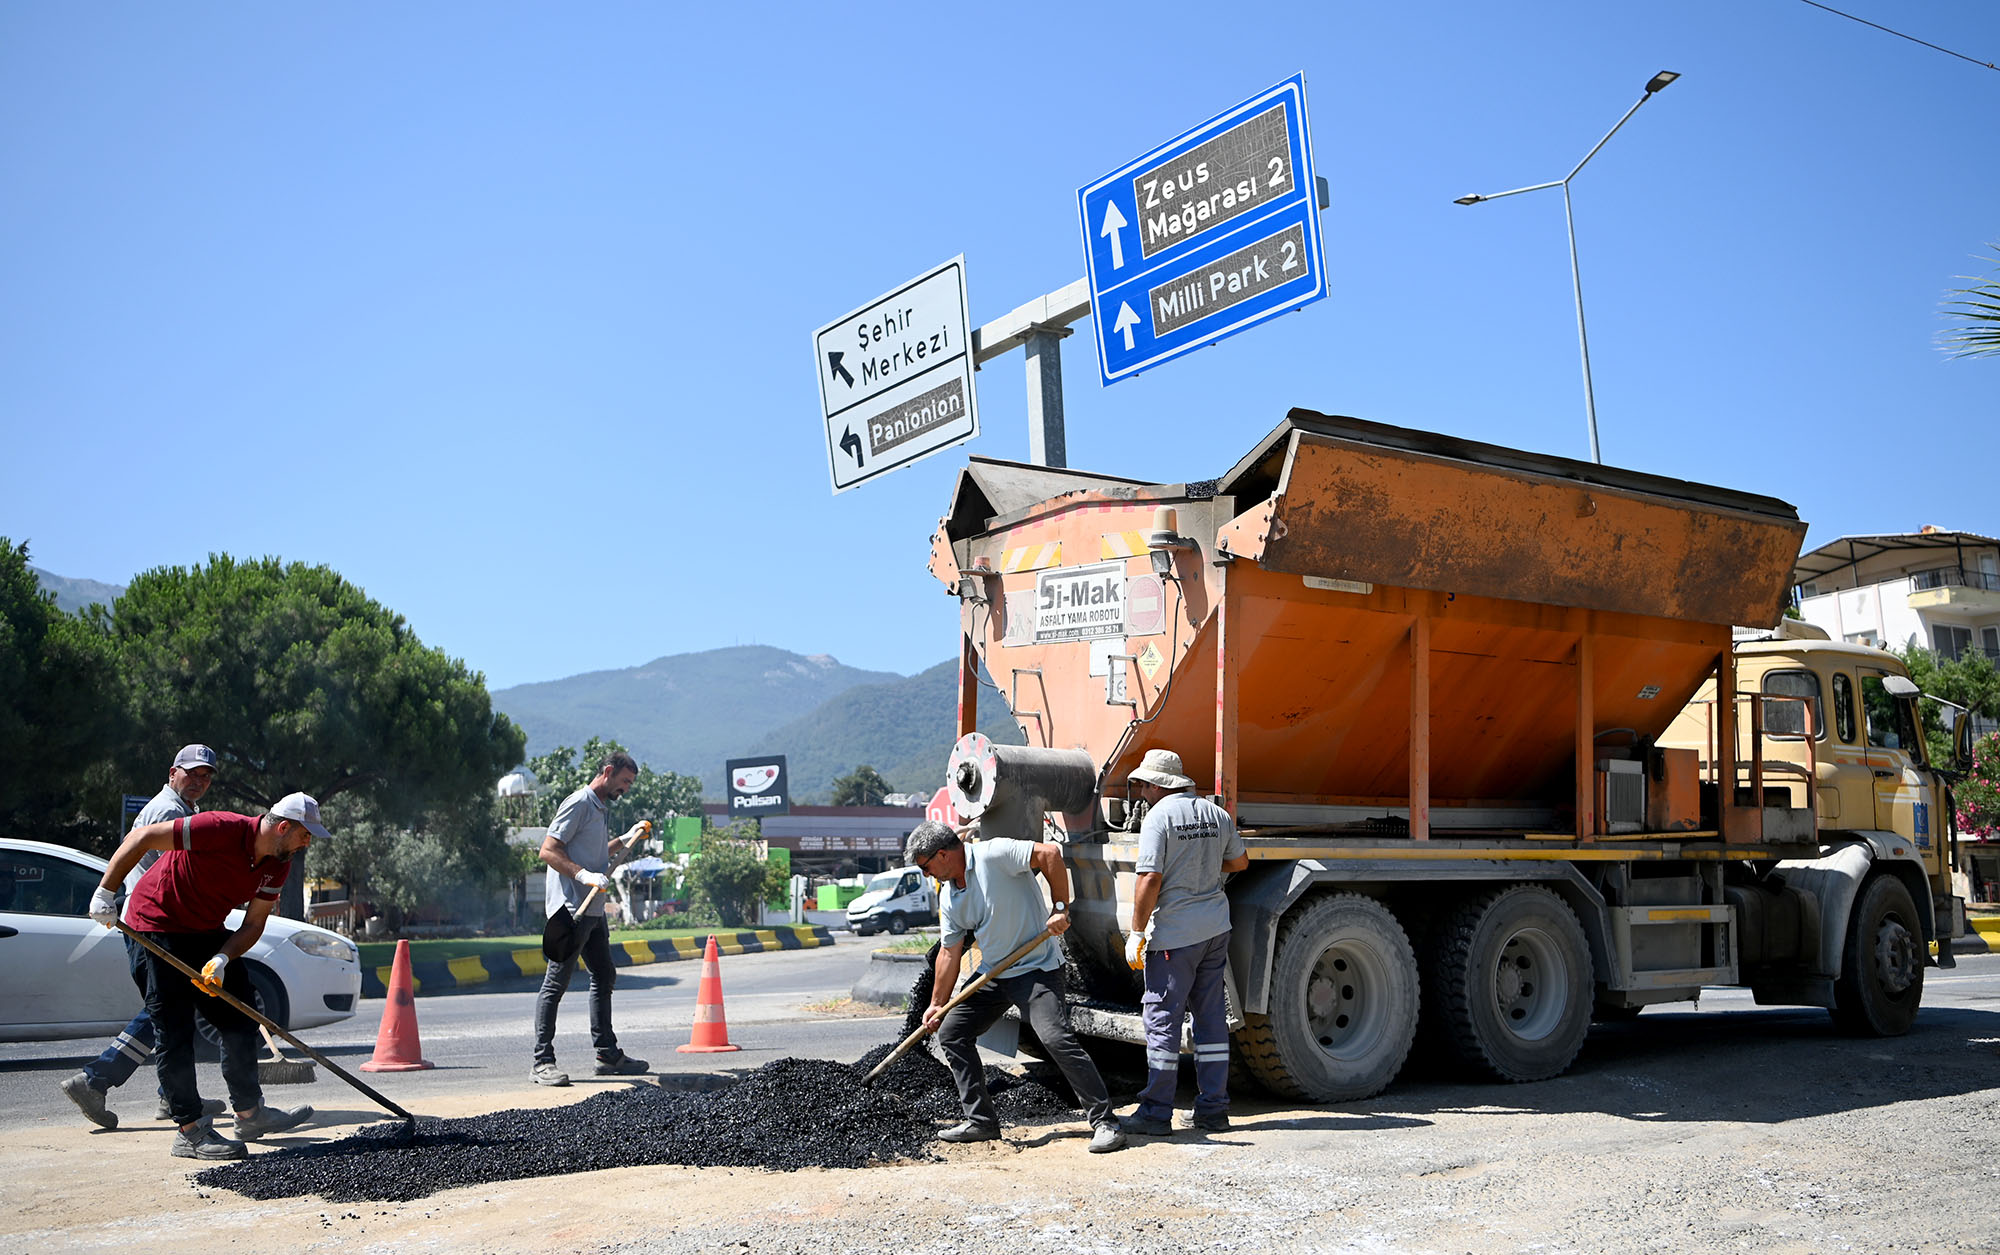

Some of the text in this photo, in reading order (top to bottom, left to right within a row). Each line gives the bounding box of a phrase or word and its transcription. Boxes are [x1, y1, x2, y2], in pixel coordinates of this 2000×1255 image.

[1143, 162, 1209, 210] Zeus
[1147, 156, 1285, 244] Mağarası 2
[1158, 241, 1298, 323] Milli Park 2
[858, 308, 913, 351] Şehir
[862, 325, 949, 386] Merkezi
[872, 394, 960, 447] Panionion
[1040, 570, 1120, 610] Si-Mak
[1040, 608, 1120, 627] ASFALT YAMA ROBOTU
[733, 795, 782, 808] Polisan
